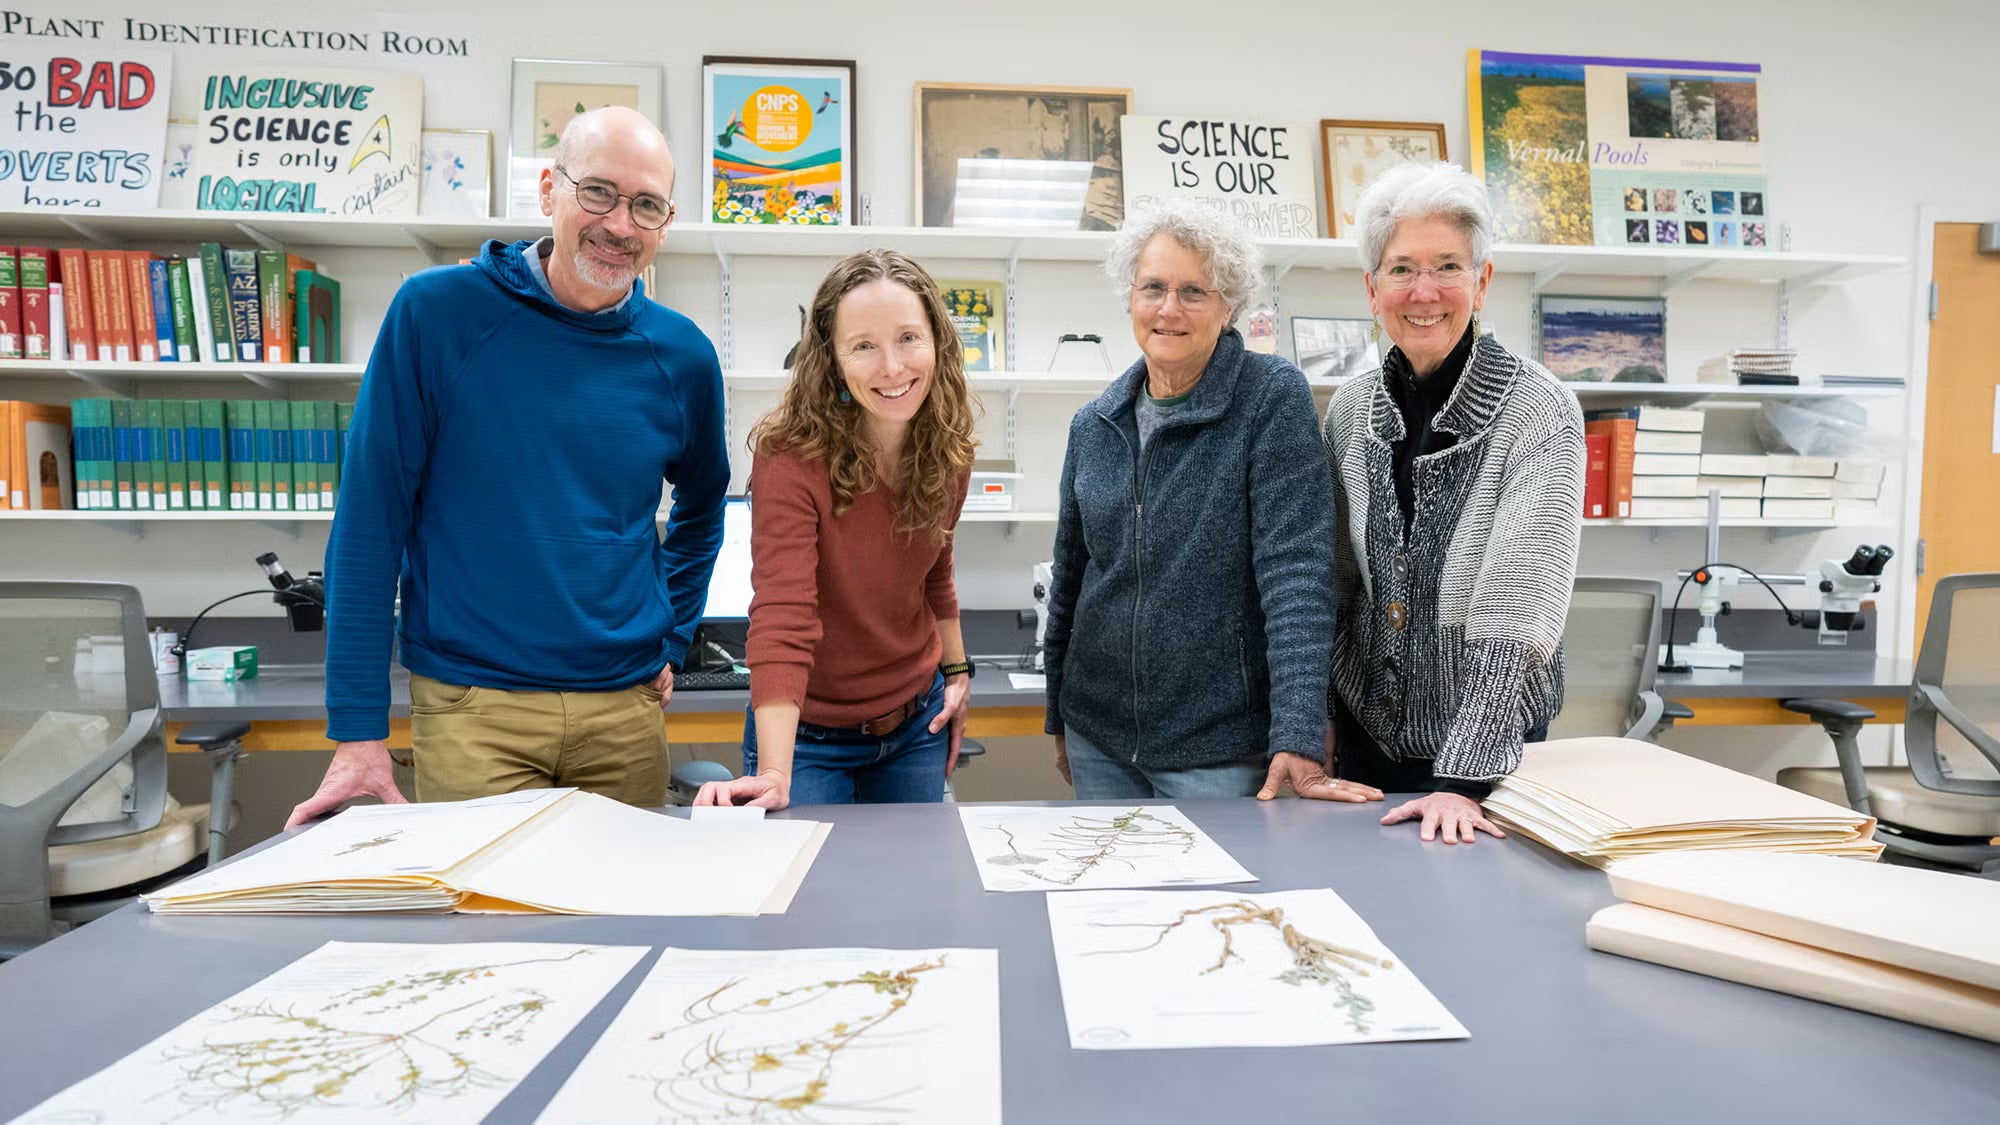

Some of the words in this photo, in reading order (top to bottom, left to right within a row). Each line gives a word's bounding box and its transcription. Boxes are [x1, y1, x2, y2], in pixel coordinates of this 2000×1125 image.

[1, 10, 104, 38] PLANT
[123, 17, 369, 52] IDENTIFICATION
[383, 32, 469, 57] ROOM
[48, 57, 155, 111] BAD
[204, 75, 375, 111] INCLUSIVE
[15, 101, 77, 133] the
[757, 93, 799, 111] CNPS
[209, 115, 353, 146] SCIENCE
[1157, 119, 1290, 160] SCIENCE
[237, 149, 260, 168] is
[279, 148, 338, 173] only
[1507, 139, 1586, 163] Vernal
[1593, 143, 1649, 165] Pools
[1172, 160, 1200, 188] IS
[1215, 161, 1278, 195] OUR
[176, 298, 187, 328] Garden
[233, 300, 247, 341] PLANTS
[247, 299, 261, 340] GARDEN
